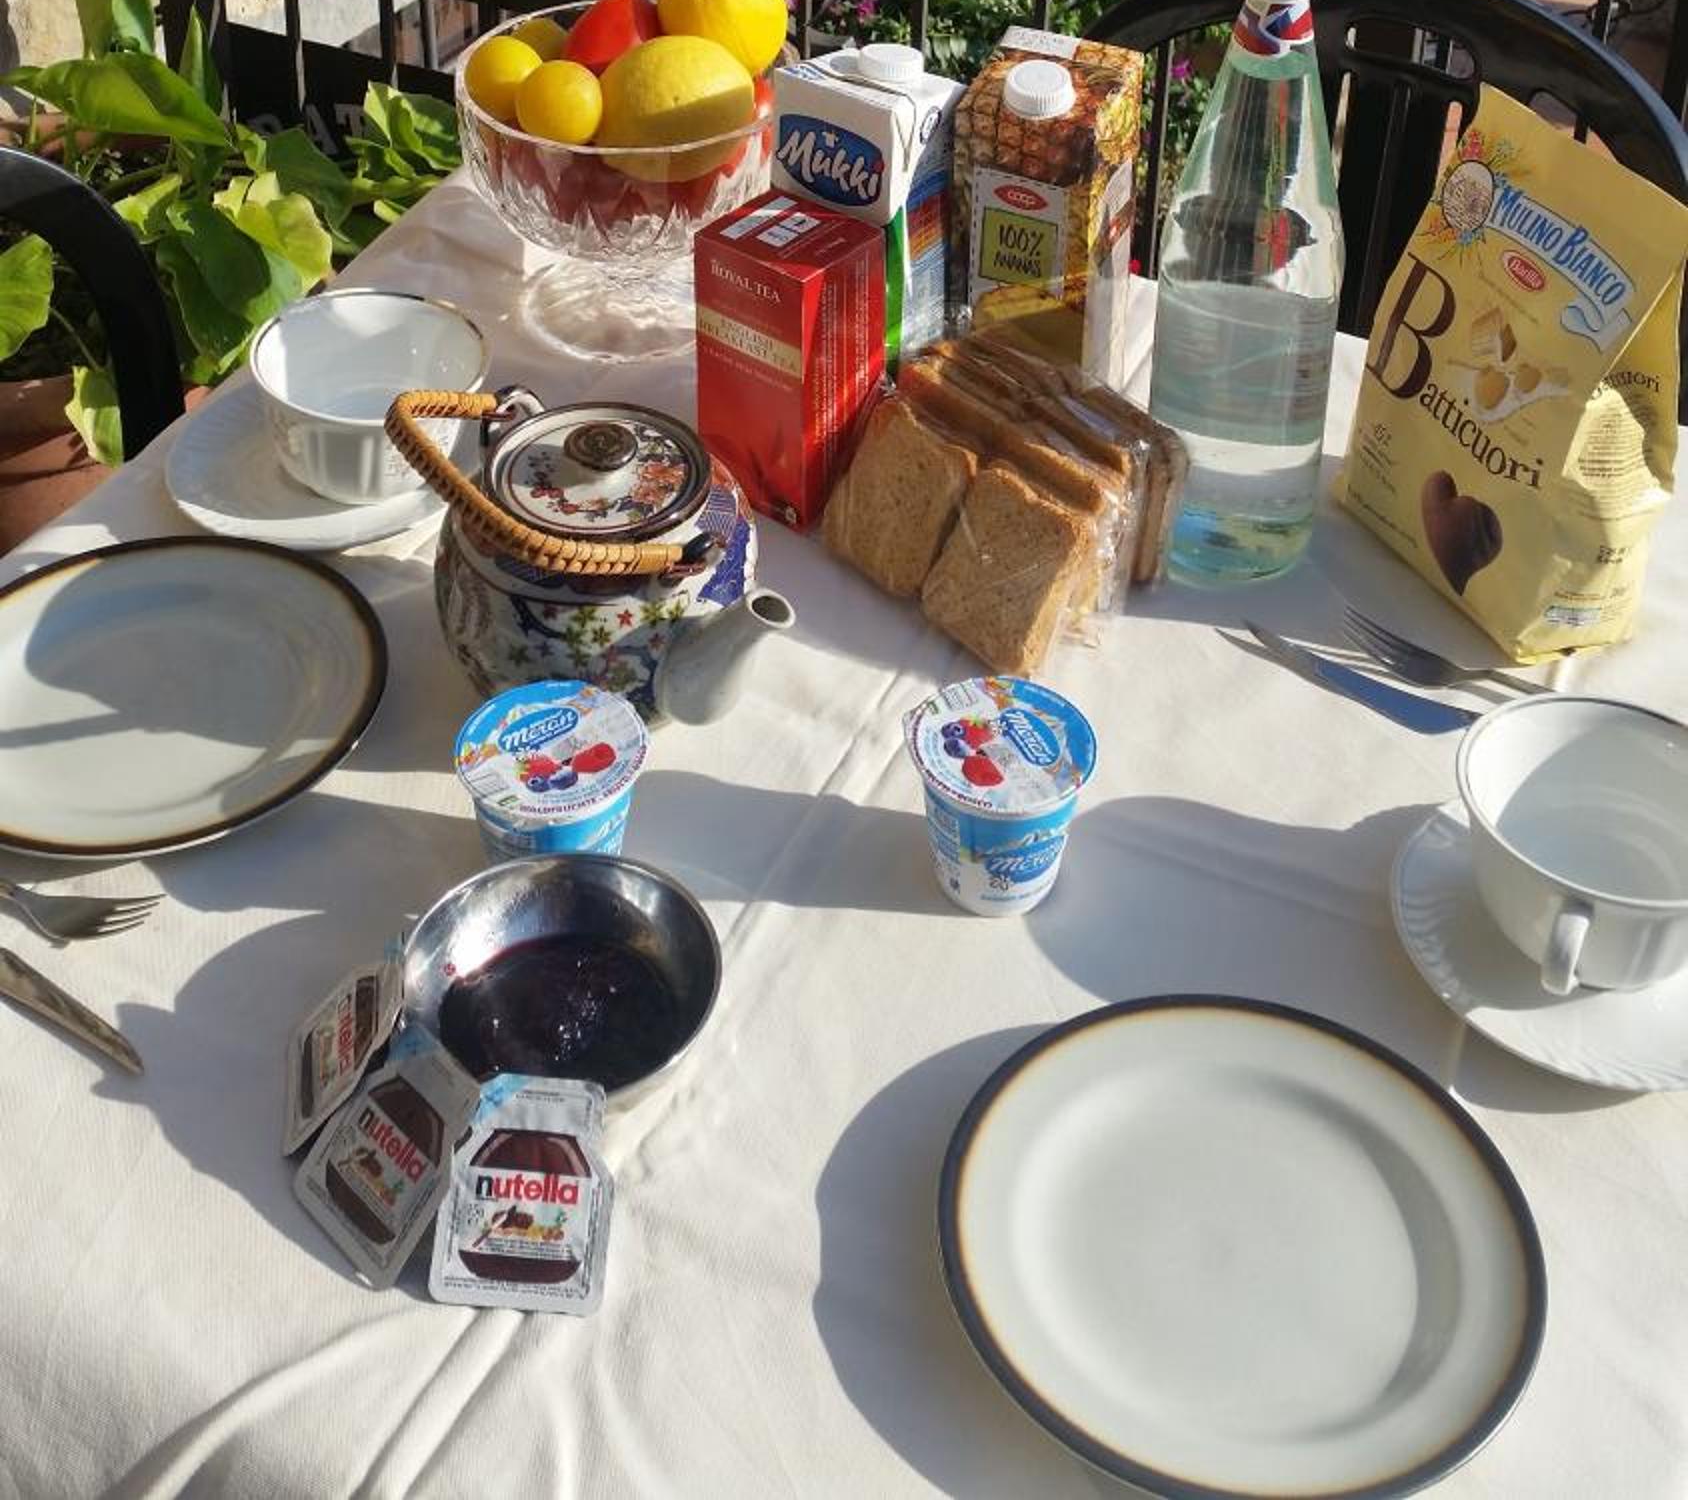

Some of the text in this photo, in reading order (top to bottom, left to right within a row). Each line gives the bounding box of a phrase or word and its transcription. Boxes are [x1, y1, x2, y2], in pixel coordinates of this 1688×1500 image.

[776, 129, 885, 198] Mukki
[999, 224, 1044, 257] 100%
[1491, 185, 1564, 252] MULINO
[1552, 226, 1627, 306] BIANCO
[993, 254, 1042, 279] ANANAS
[754, 281, 782, 304] TEA
[1366, 250, 1543, 491] Batticuori
[358, 1106, 428, 1184] nutella
[475, 1172, 580, 1206] nutella
